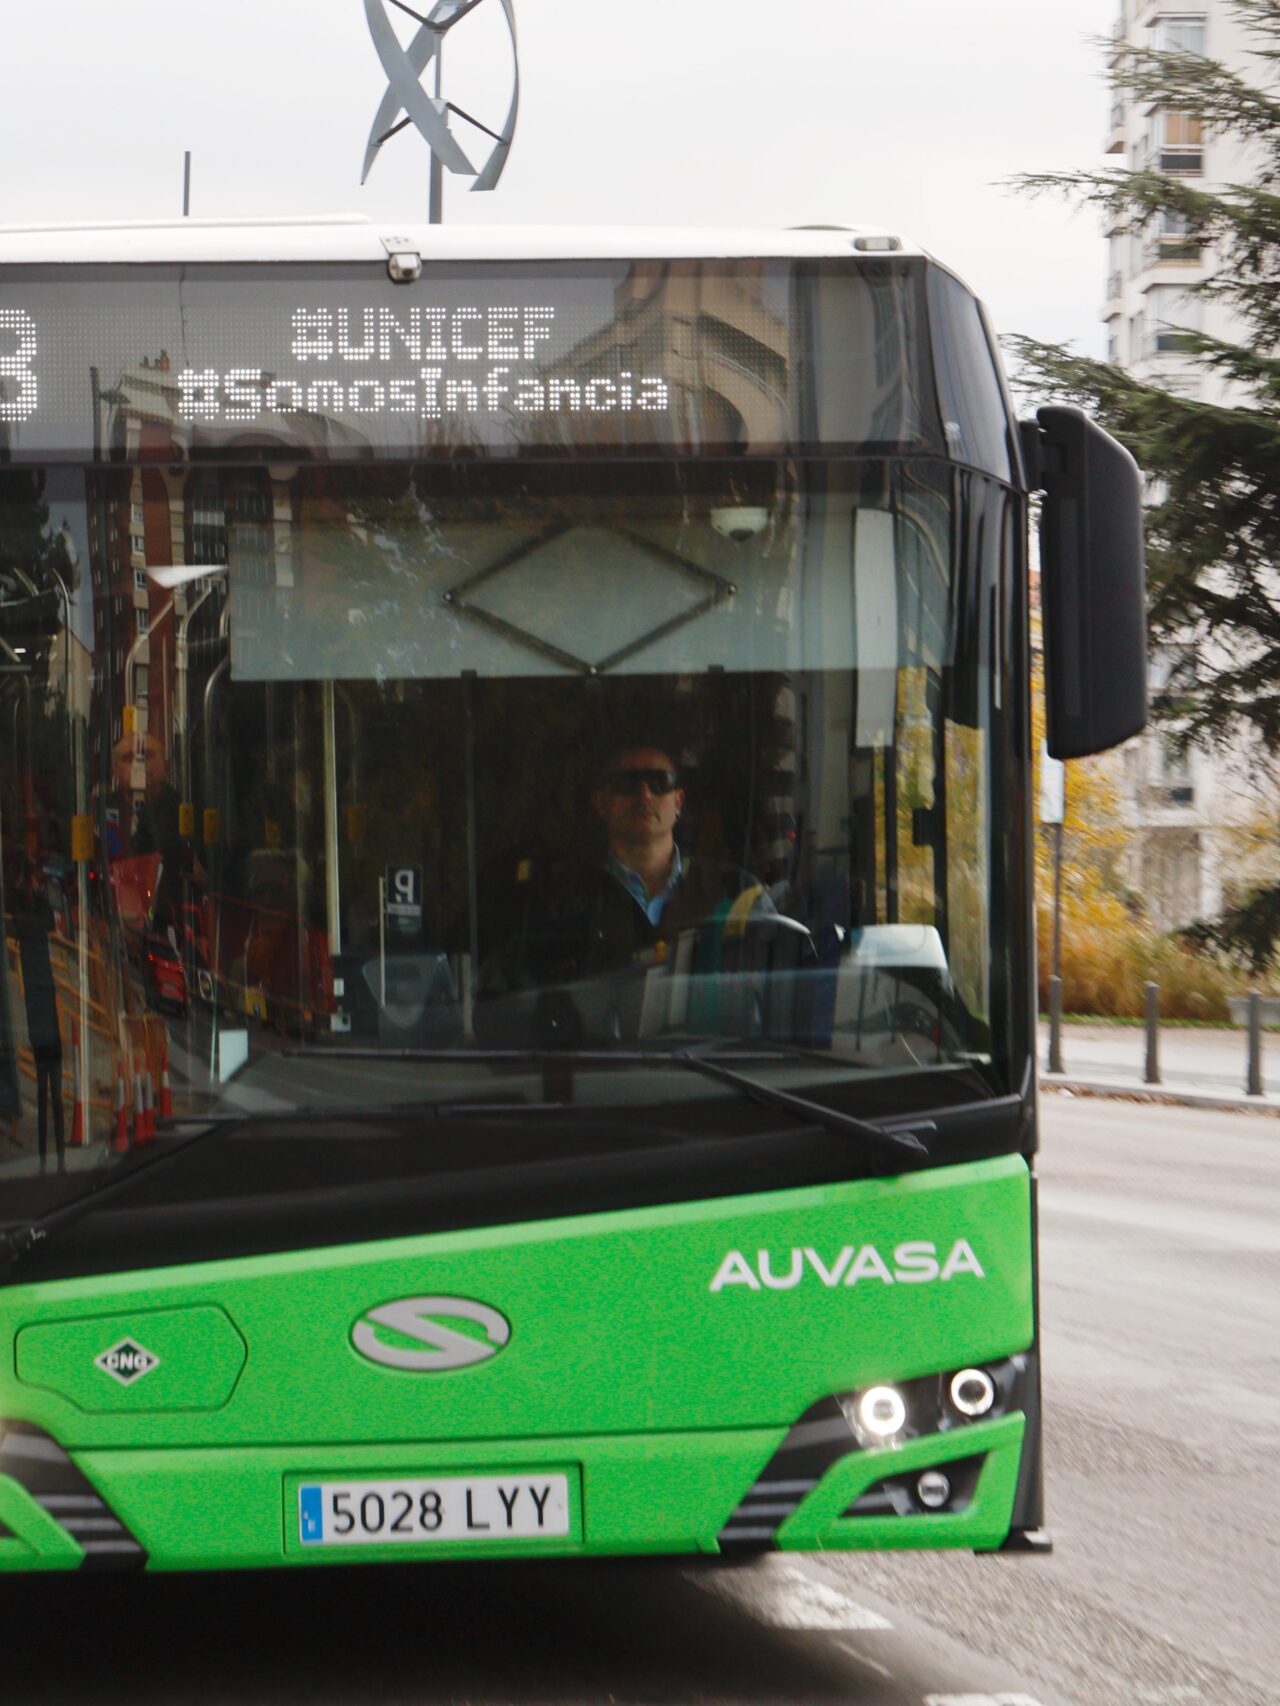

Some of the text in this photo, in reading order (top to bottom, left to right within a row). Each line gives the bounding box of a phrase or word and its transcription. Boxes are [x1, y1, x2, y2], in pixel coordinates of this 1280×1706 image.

[291, 307, 554, 361] #UNICEF
[177, 367, 668, 420] #SomosInfancia
[709, 1238, 986, 1293] AUVASA
[106, 1351, 149, 1371] CNG
[332, 1486, 550, 1535] 5028 LYY
